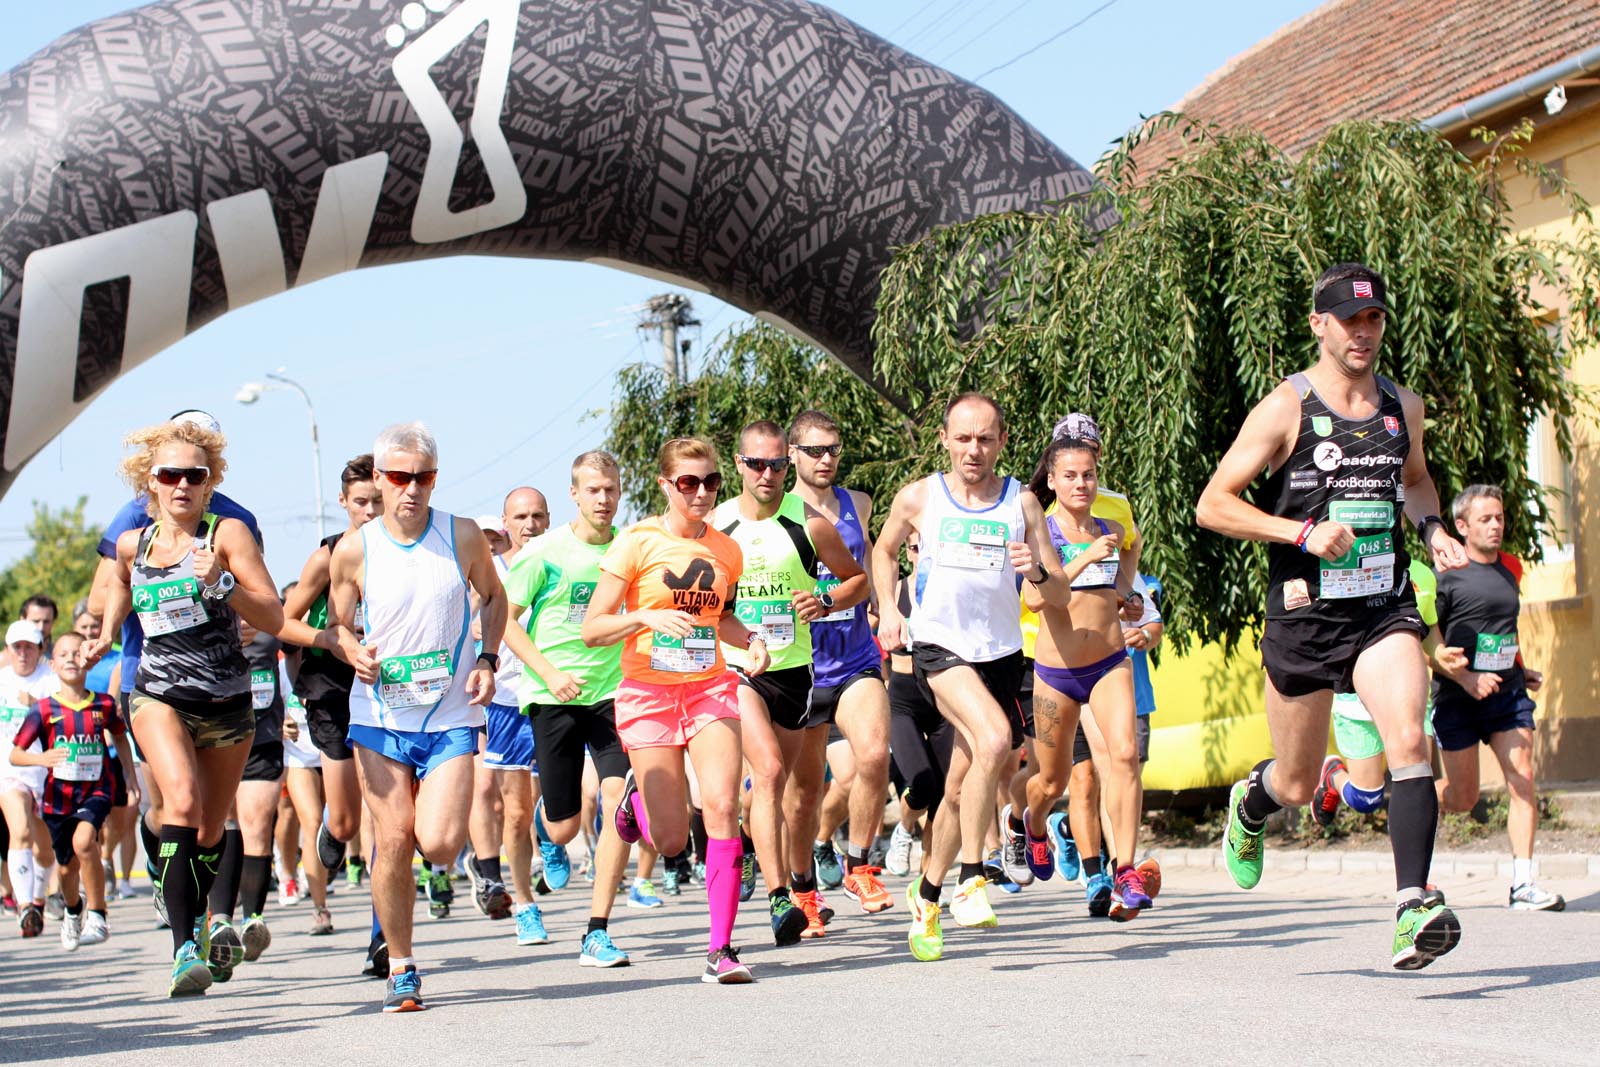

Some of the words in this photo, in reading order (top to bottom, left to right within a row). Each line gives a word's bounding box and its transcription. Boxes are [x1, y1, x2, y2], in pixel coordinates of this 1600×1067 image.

[970, 523, 992, 535] 051
[1358, 540, 1380, 554] 048
[158, 585, 180, 598] 002
[761, 603, 782, 614] 016
[410, 657, 434, 670] 089
